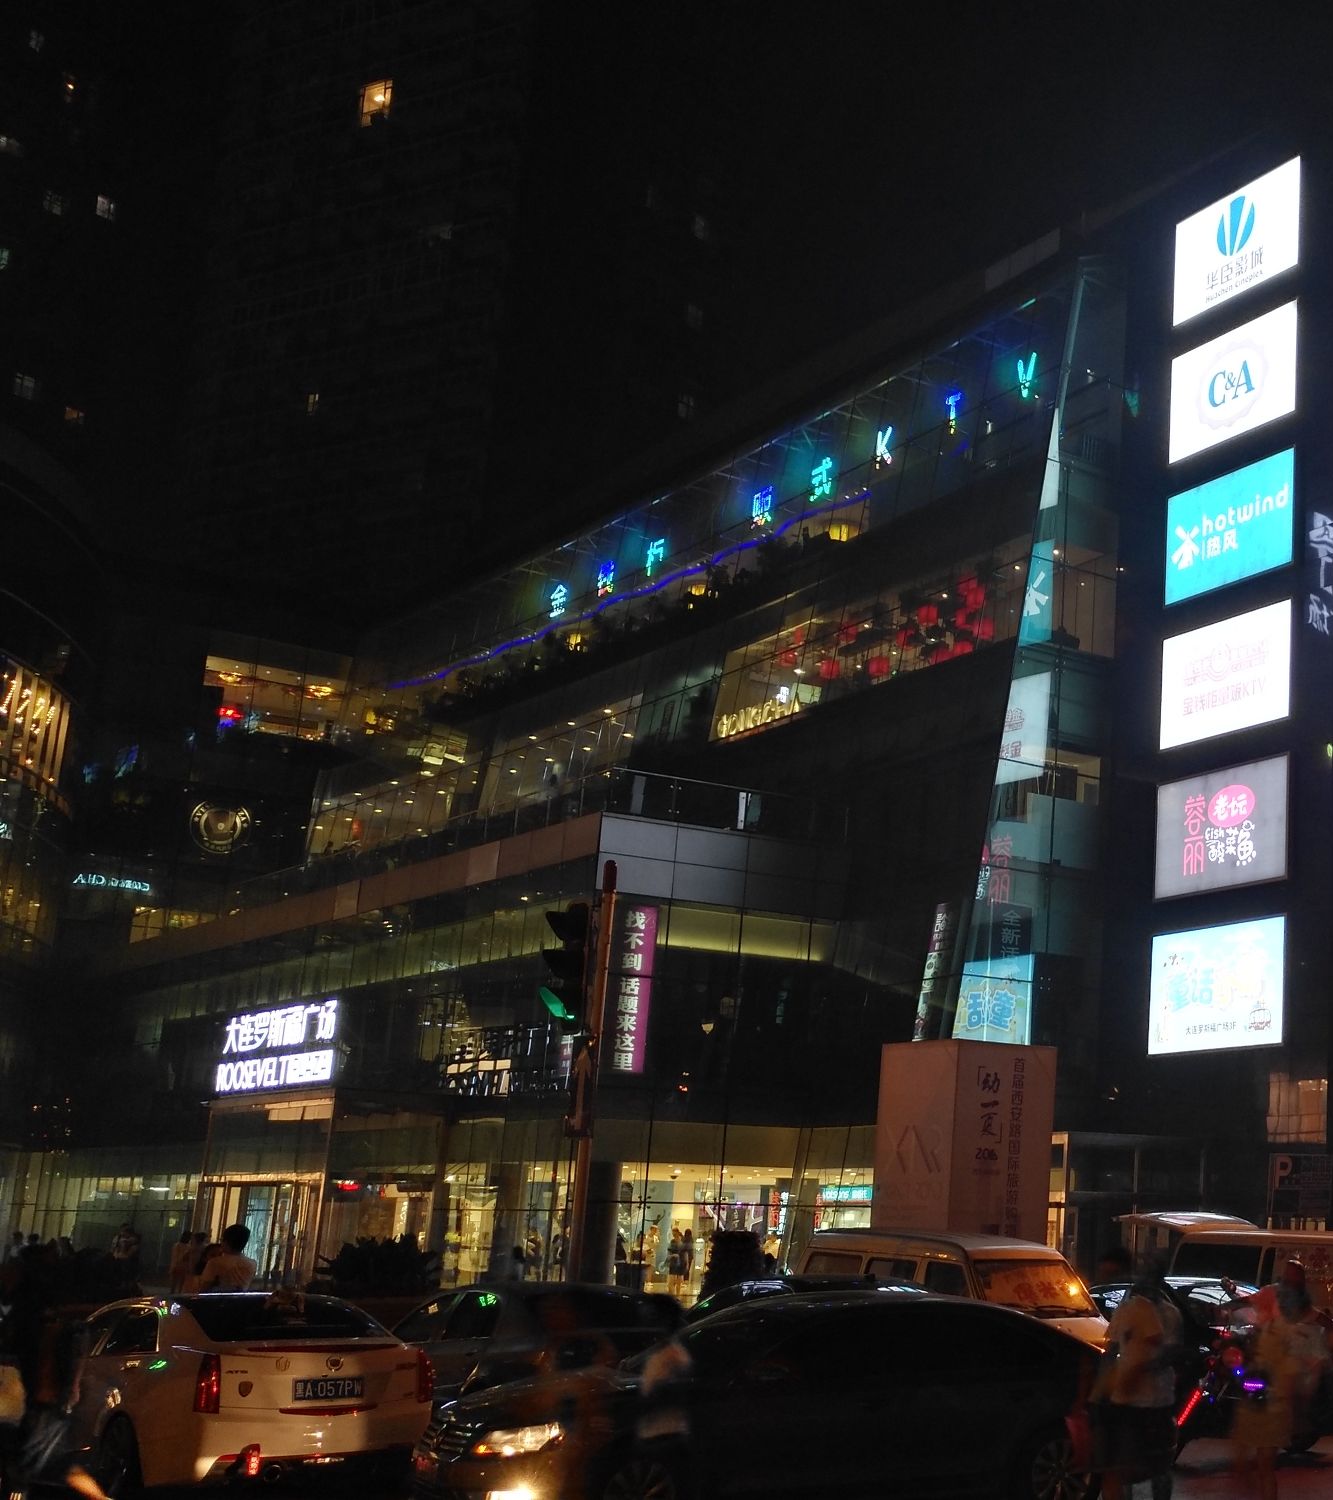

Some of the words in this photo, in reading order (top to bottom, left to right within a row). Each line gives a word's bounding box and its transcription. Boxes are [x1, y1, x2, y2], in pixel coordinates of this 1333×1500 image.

[1206, 245, 1264, 290] 华臣影城
[1208, 360, 1255, 408] C&A
[1202, 484, 1289, 537] hotwind
[1206, 528, 1238, 559] 热风
[1213, 793, 1248, 821] 老坛
[1183, 793, 1206, 876] 蓉丽
[612, 910, 646, 1072] 找不到话题来这里
[222, 1000, 338, 1054] 大连罗斯福广场
[215, 1055, 289, 1092] ROOSEVELT
